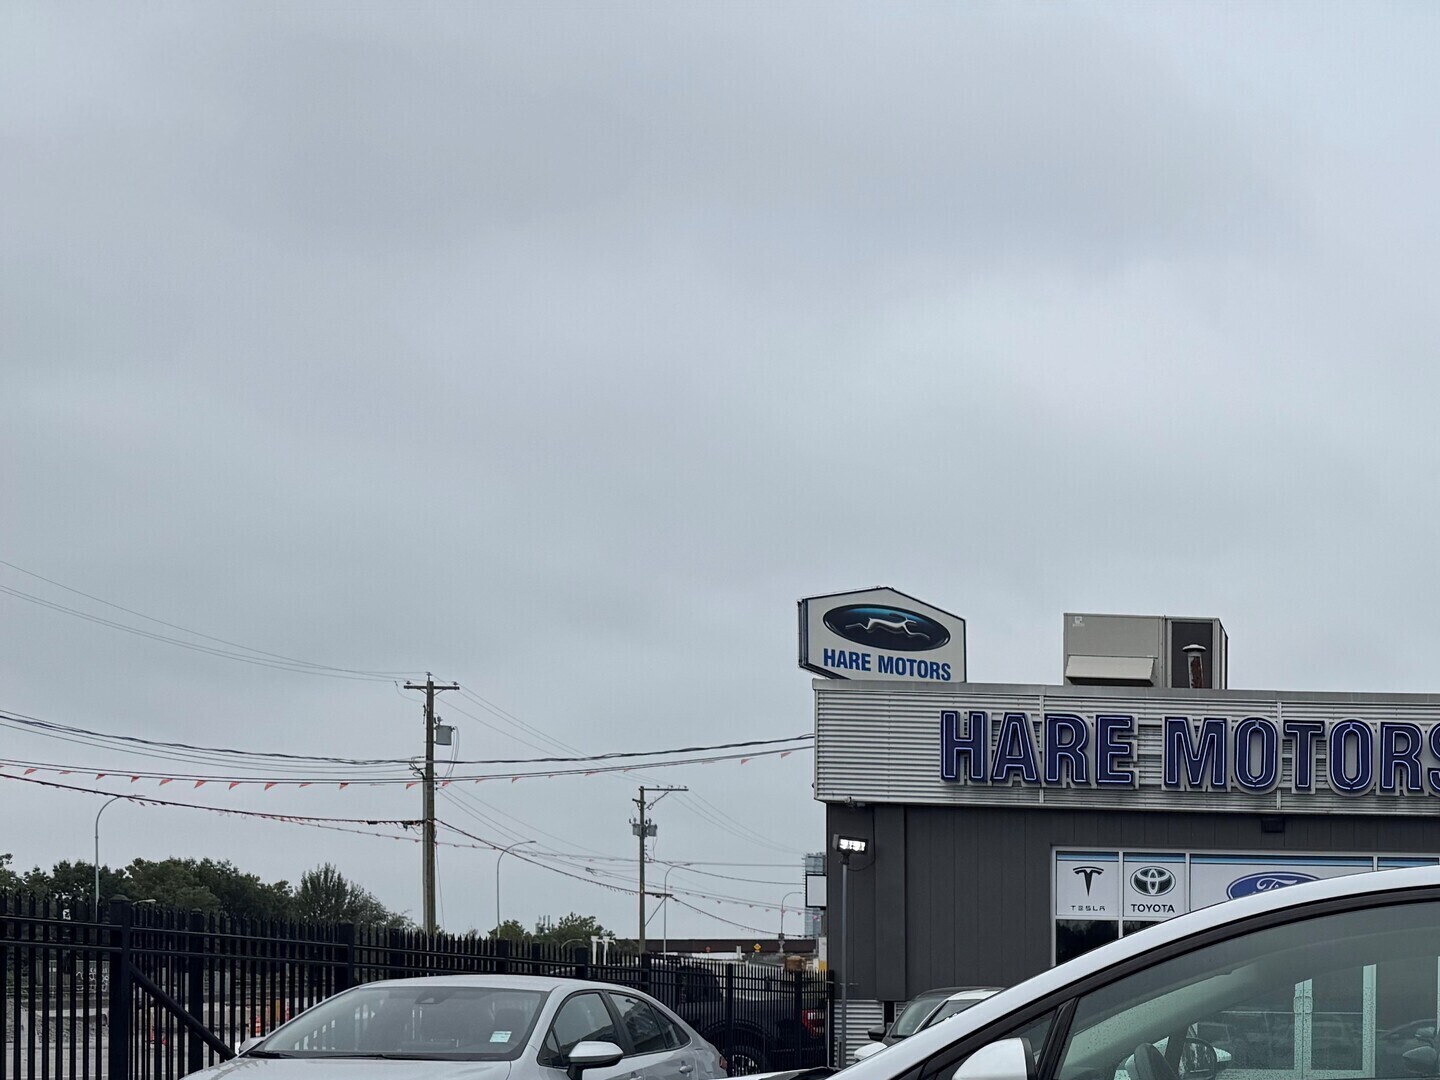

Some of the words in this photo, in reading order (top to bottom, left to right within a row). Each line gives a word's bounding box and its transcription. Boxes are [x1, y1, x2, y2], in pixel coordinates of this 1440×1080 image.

[823, 648, 871, 671] HARE
[878, 655, 952, 681] MOTORS
[939, 709, 1138, 786] HARE
[1130, 903, 1175, 913] TOYOTA
